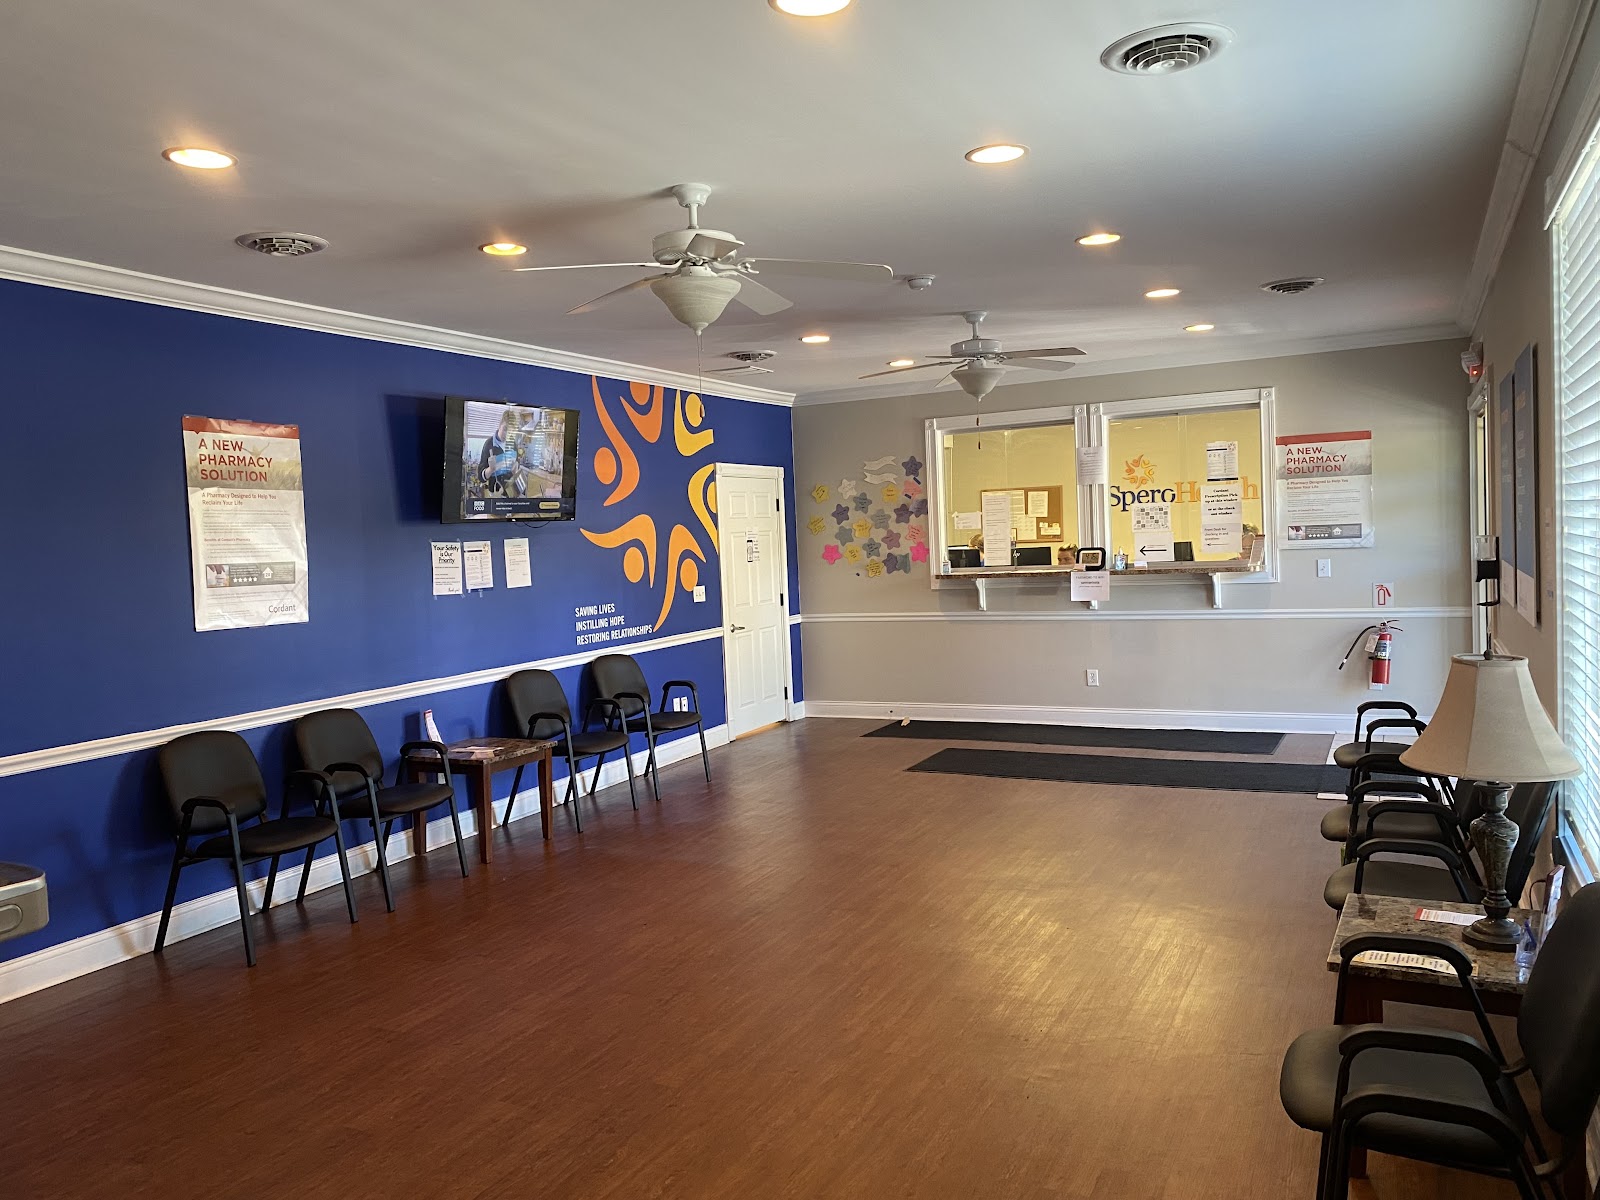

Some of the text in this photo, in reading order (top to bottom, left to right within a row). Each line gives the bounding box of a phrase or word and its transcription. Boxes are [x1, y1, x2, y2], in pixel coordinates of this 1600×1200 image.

[199, 438, 243, 452] A NEW
[1286, 446, 1323, 456] A NEW
[199, 453, 273, 469] PHARMACY
[1286, 454, 1347, 465] PHARMACY
[200, 468, 268, 483] SOLUTION
[1286, 464, 1341, 475] SOLUTION
[445, 544, 459, 552] Safety
[438, 556, 456, 565] Priority
[268, 604, 296, 614] Cordant
[575, 603, 615, 618] SAVING LIVES
[576, 615, 625, 632] INSTILLING HOPE
[576, 624, 653, 646] RESTORING RELATIONSHIPS
